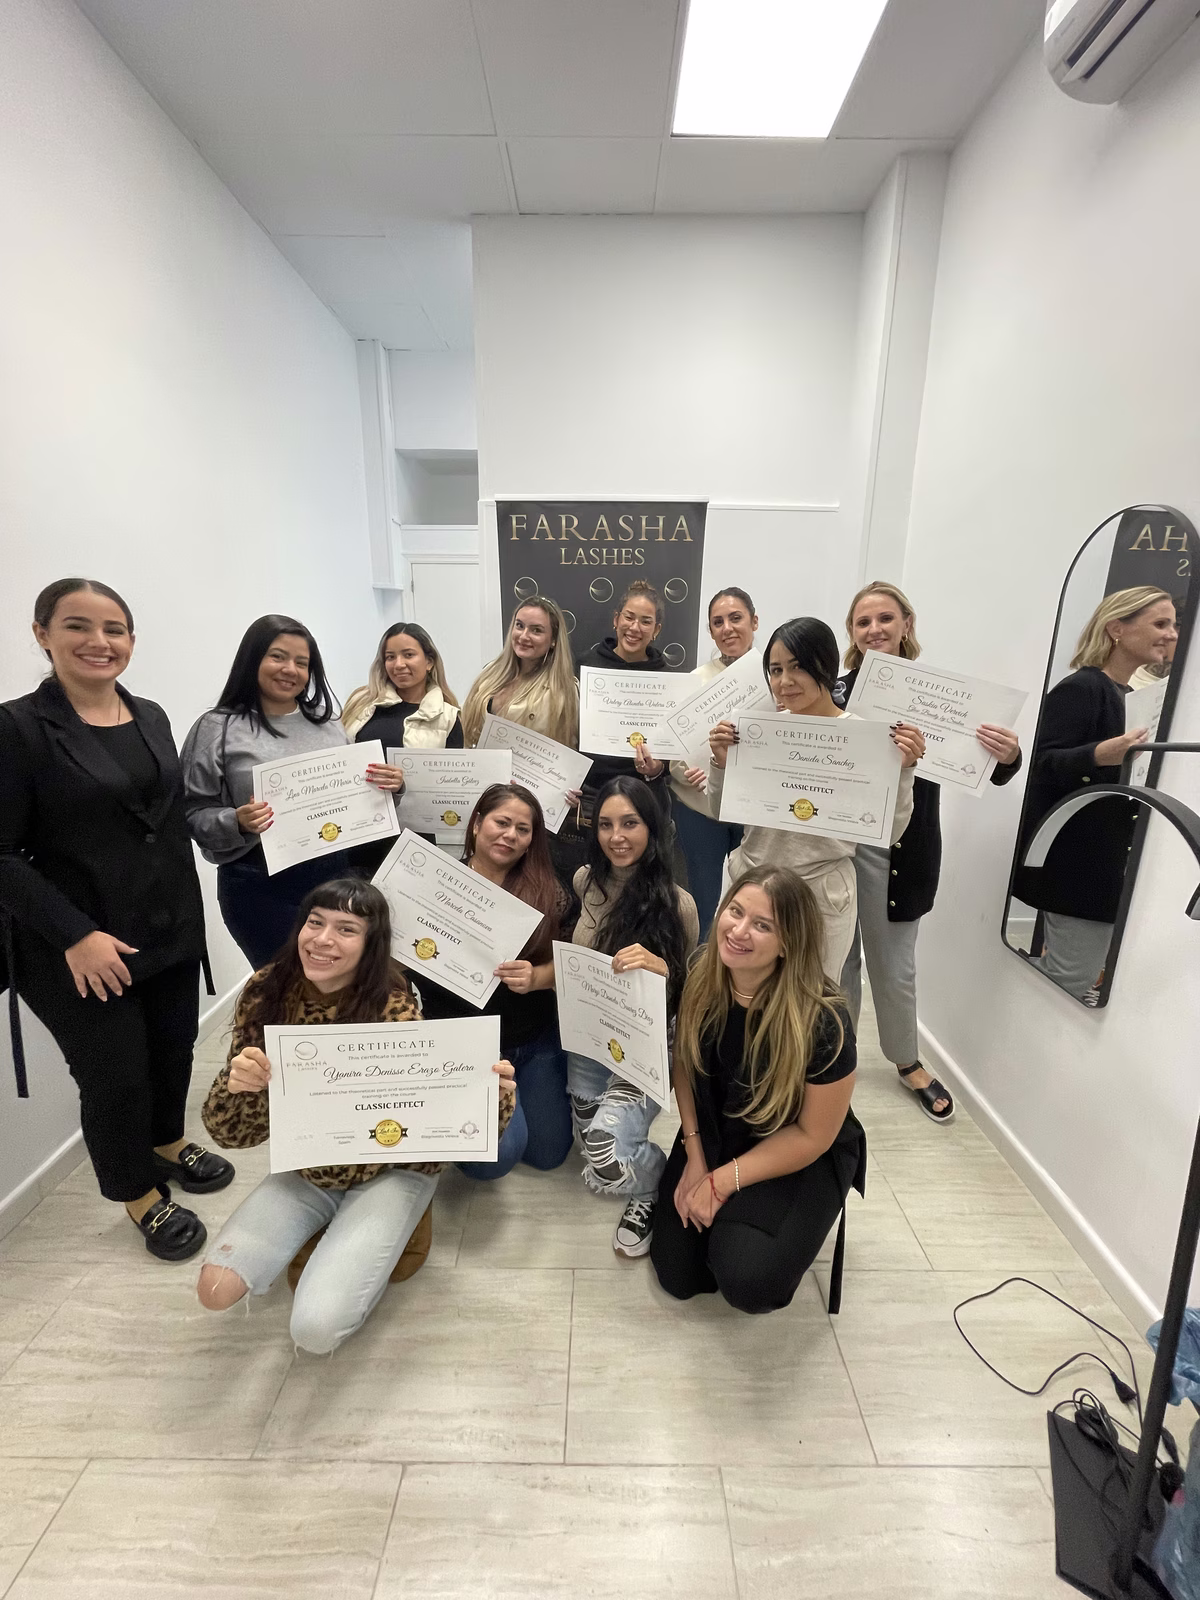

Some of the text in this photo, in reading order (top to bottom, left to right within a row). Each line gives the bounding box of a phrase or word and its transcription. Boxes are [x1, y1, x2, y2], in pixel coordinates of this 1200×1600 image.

[509, 513, 694, 542] FARASHA
[559, 547, 646, 566] LASHES
[615, 682, 666, 690] CERTIFICATE
[694, 679, 738, 713] CERTIFICATE
[904, 676, 973, 701] CERTIFICATE
[775, 729, 849, 744] CERTIFICATE
[515, 736, 559, 760] CERTIFICATE
[291, 760, 348, 778] CERTIFICATE
[788, 750, 855, 770] Daniela Sanchez
[511, 771, 525, 782] LASSIC
[781, 782, 834, 795] CLASSIC EFFECT
[306, 811, 328, 820] CLASSIC
[330, 806, 348, 815] EFFECT
[436, 868, 496, 909] CERTIFICATE
[435, 891, 463, 914] Marcela
[416, 916, 441, 933] CLASSIC
[440, 930, 462, 946] EFFECT
[587, 964, 631, 989] CERTIFICATE
[337, 1039, 436, 1052] CERTIFICATE
[323, 1061, 474, 1084] Yanira Denisse Erazo Galera
[354, 1100, 425, 1111] CLASSIC EFFECT
